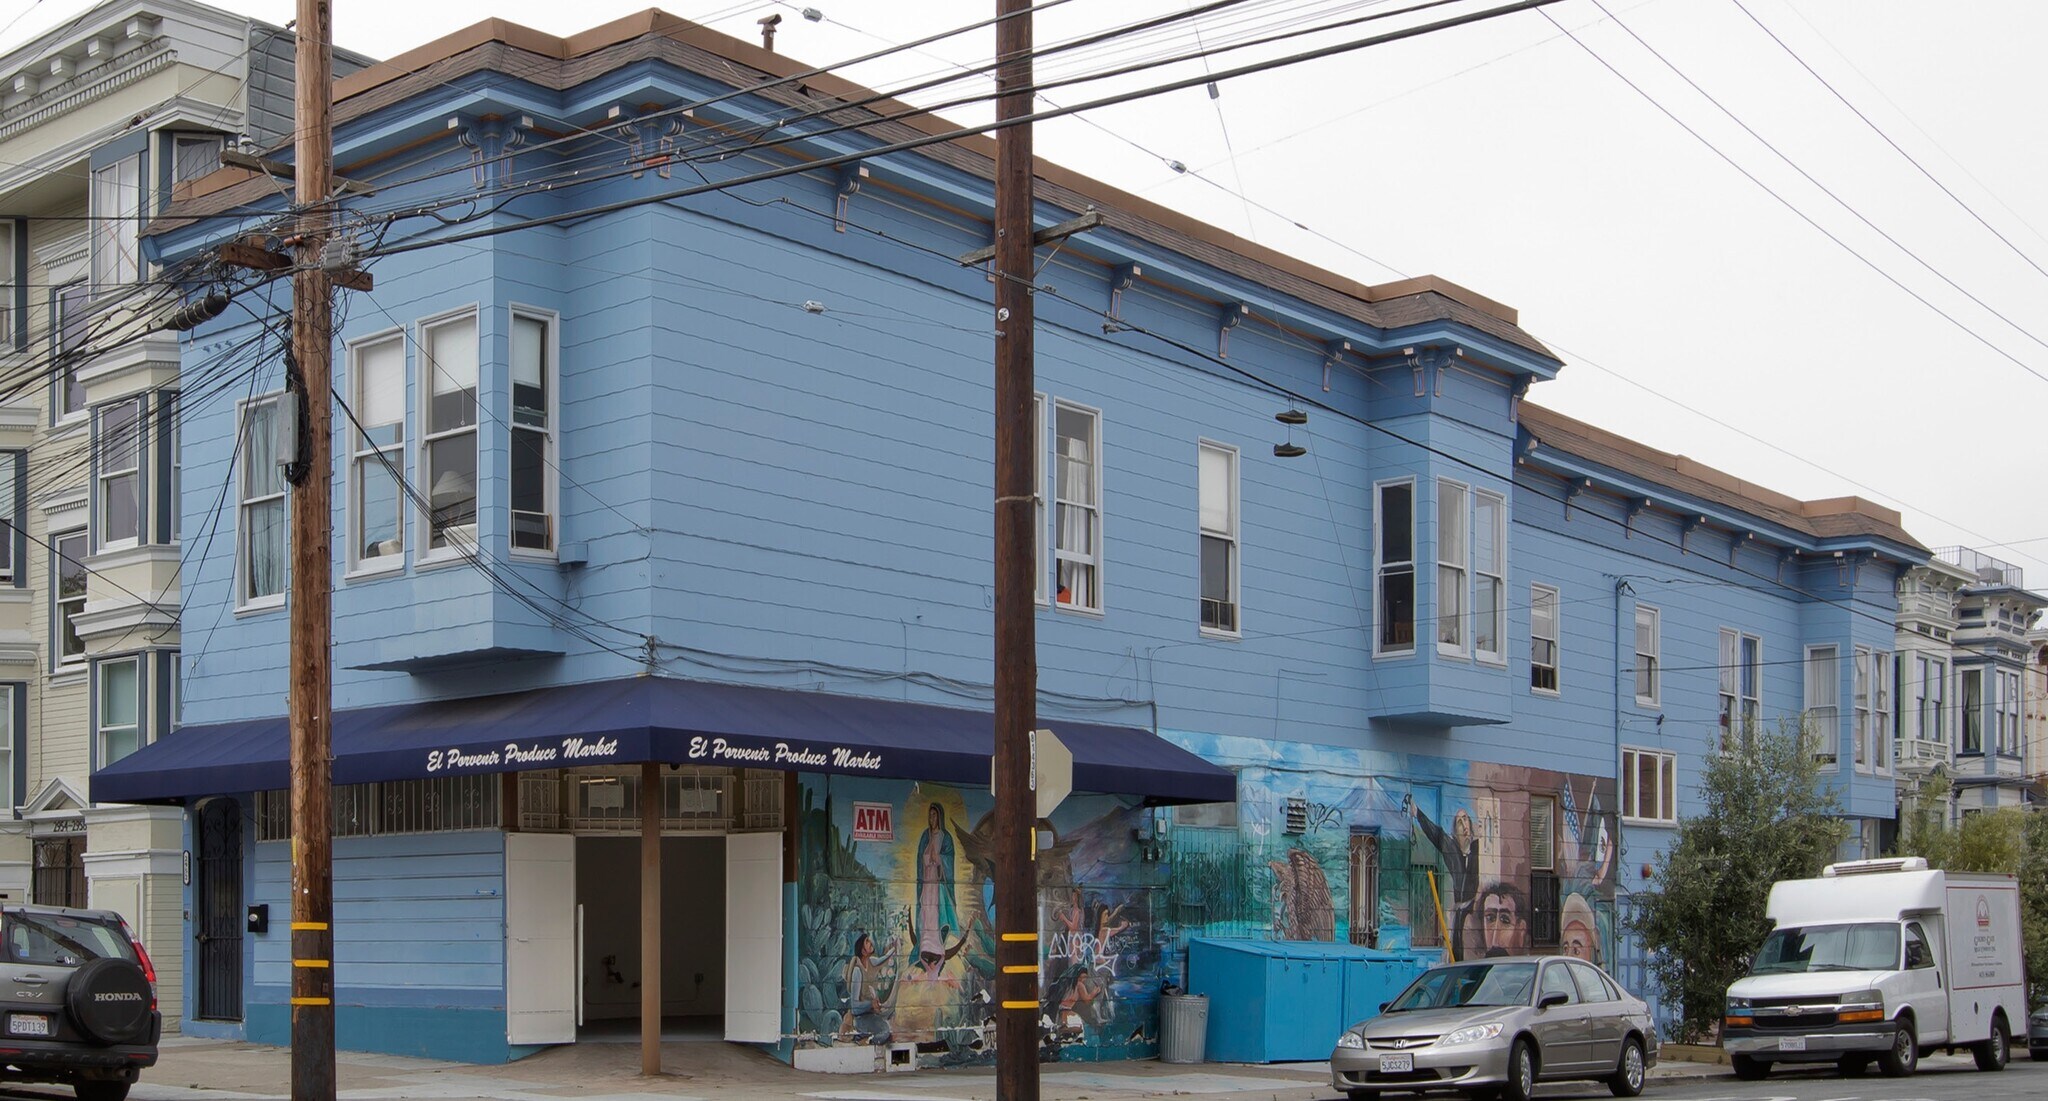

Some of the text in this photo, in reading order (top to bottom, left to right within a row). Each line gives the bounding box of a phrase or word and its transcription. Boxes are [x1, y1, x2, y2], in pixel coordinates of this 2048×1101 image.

[426, 736, 618, 772] El Porvenir Produce Market
[688, 736, 882, 770] El Porvenir Produce Market
[856, 808, 891, 831] ATM
[94, 992, 142, 1002] HONDA
[12, 1020, 46, 1032] 5PDT139
